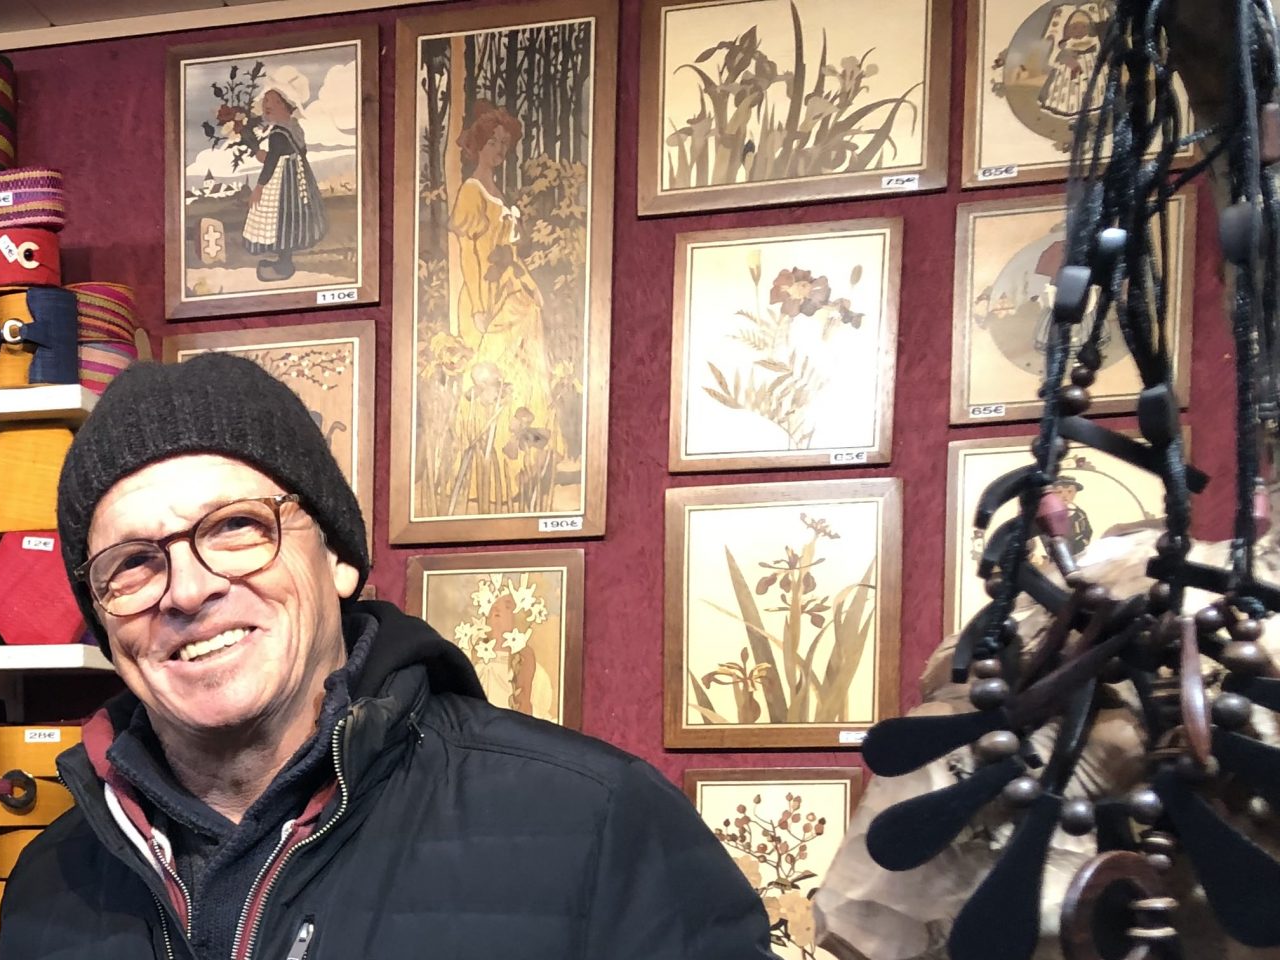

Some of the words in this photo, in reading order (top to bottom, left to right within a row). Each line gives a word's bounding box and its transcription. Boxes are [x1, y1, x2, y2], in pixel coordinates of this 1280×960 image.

[322, 291, 356, 301] 110€
[971, 406, 1003, 416] 65€
[544, 520, 579, 529] 190€
